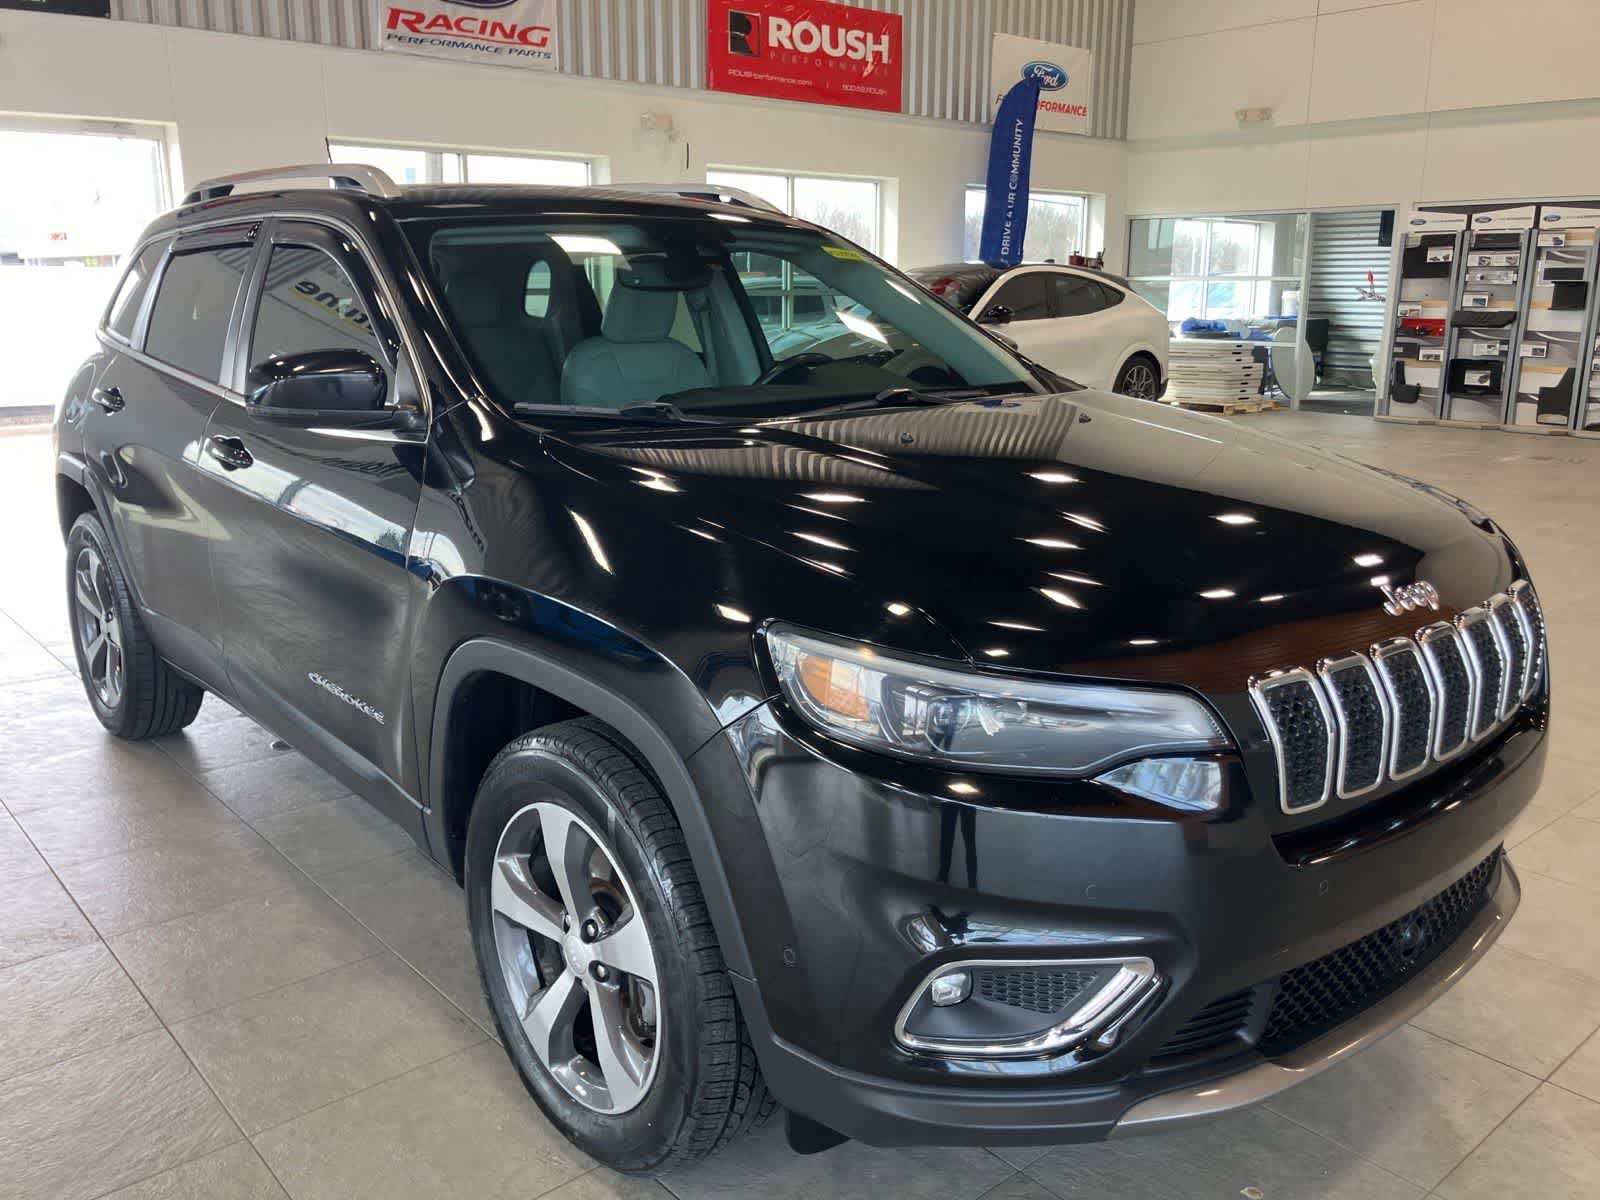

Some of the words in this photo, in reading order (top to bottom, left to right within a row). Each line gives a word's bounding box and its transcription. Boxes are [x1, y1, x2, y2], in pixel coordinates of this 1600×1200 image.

[386, 7, 551, 47] RACING
[387, 33, 503, 55] PERFORMANCE
[508, 48, 552, 60] PARTS
[768, 15, 890, 76] ROUSH
[1037, 100, 1088, 117] FORMANCE
[1001, 219, 1012, 256] DRIVE
[1380, 580, 1440, 616] Jeep
